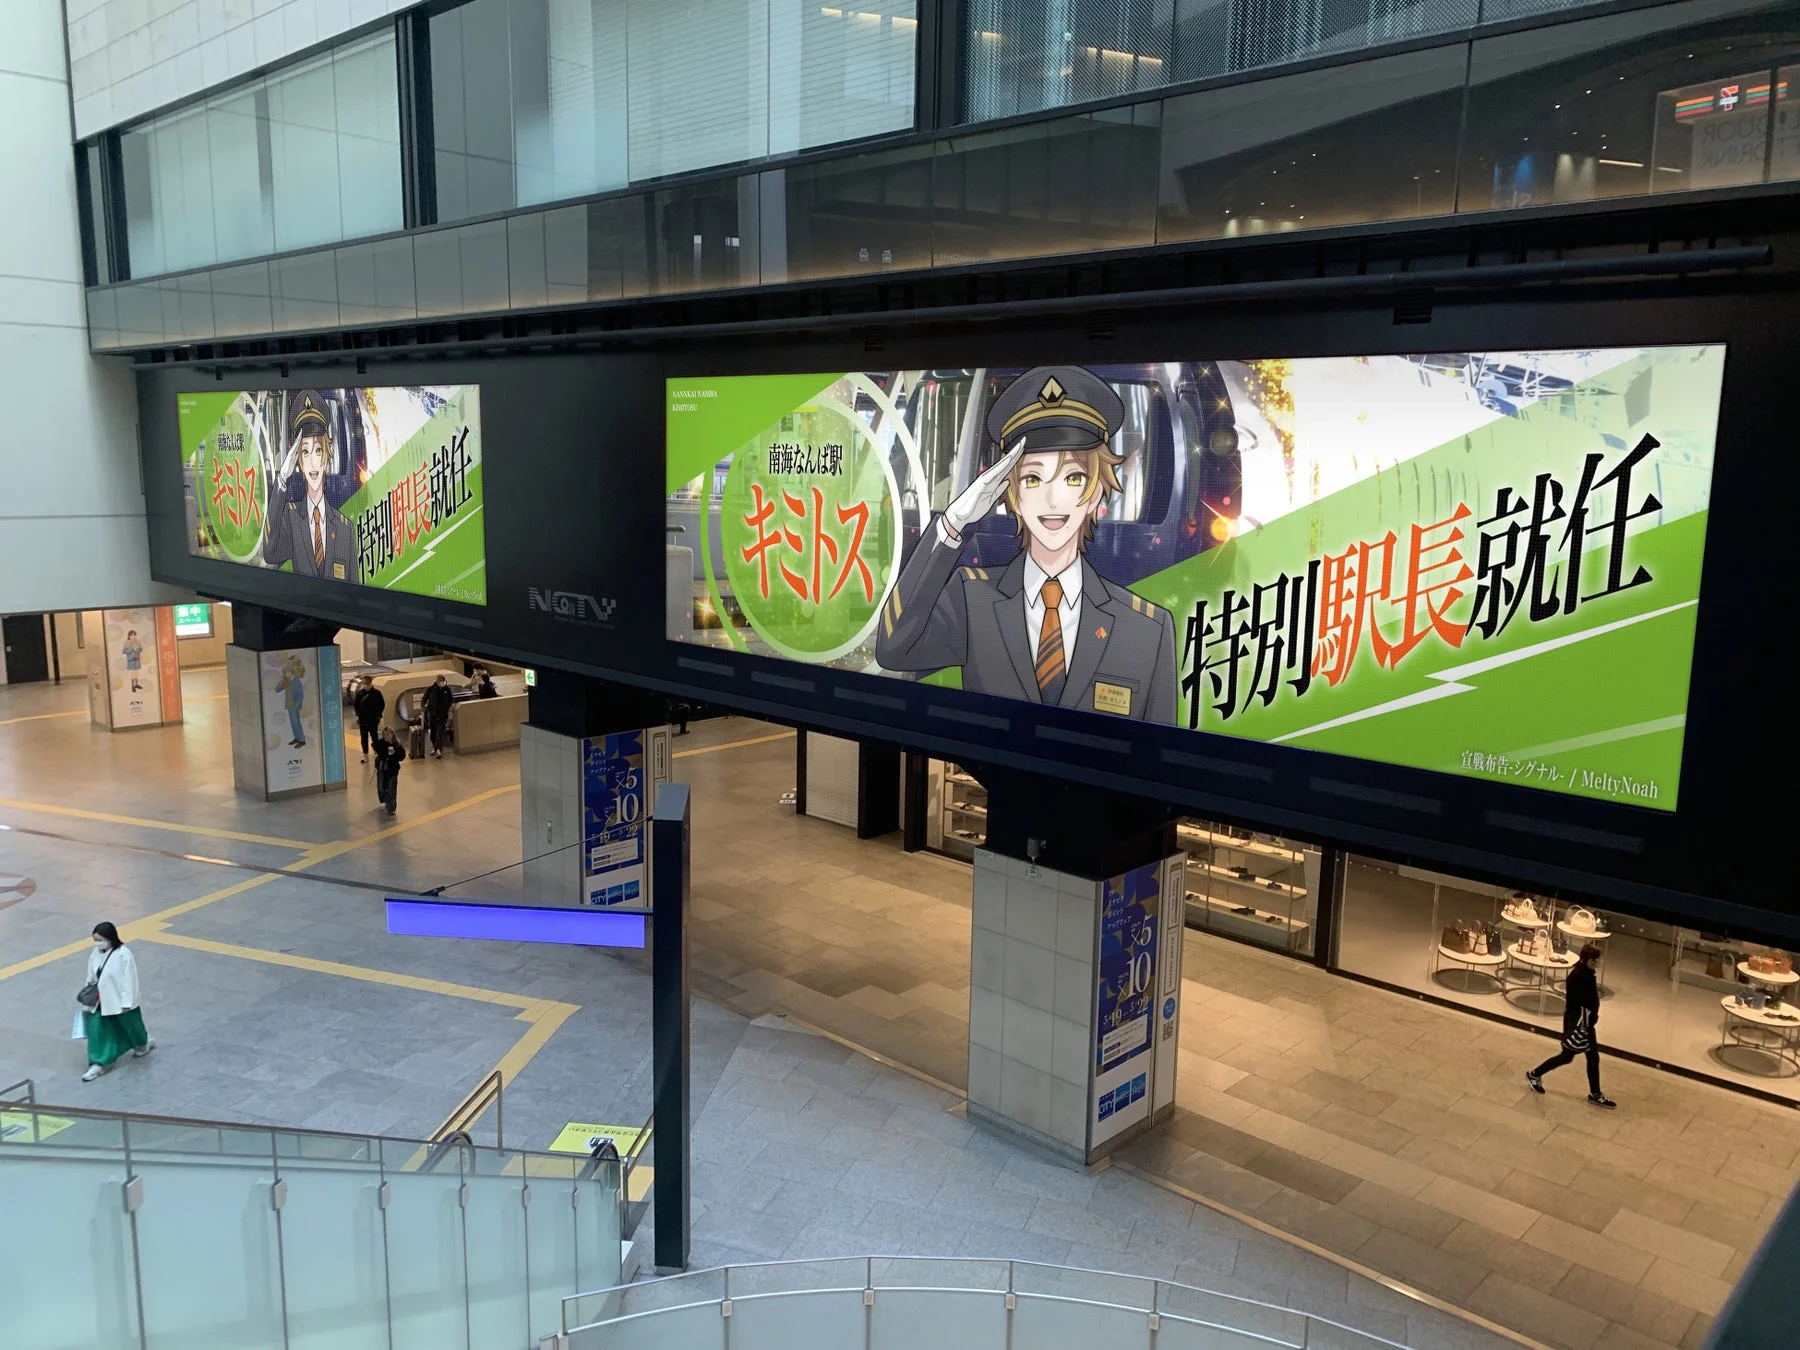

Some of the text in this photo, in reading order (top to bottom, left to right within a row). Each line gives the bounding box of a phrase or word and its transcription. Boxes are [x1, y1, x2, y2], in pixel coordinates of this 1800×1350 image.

[672, 404, 697, 412] KIMITOSU
[697, 390, 718, 398] NAMBA
[768, 443, 843, 477] 南海なんば駅
[211, 457, 261, 529] キミトス
[356, 426, 473, 584] 特別駅長就任
[742, 484, 874, 605] キミトス
[1181, 431, 1664, 730] 特別駅長就任
[1581, 769, 1659, 800] MeltyNoah
